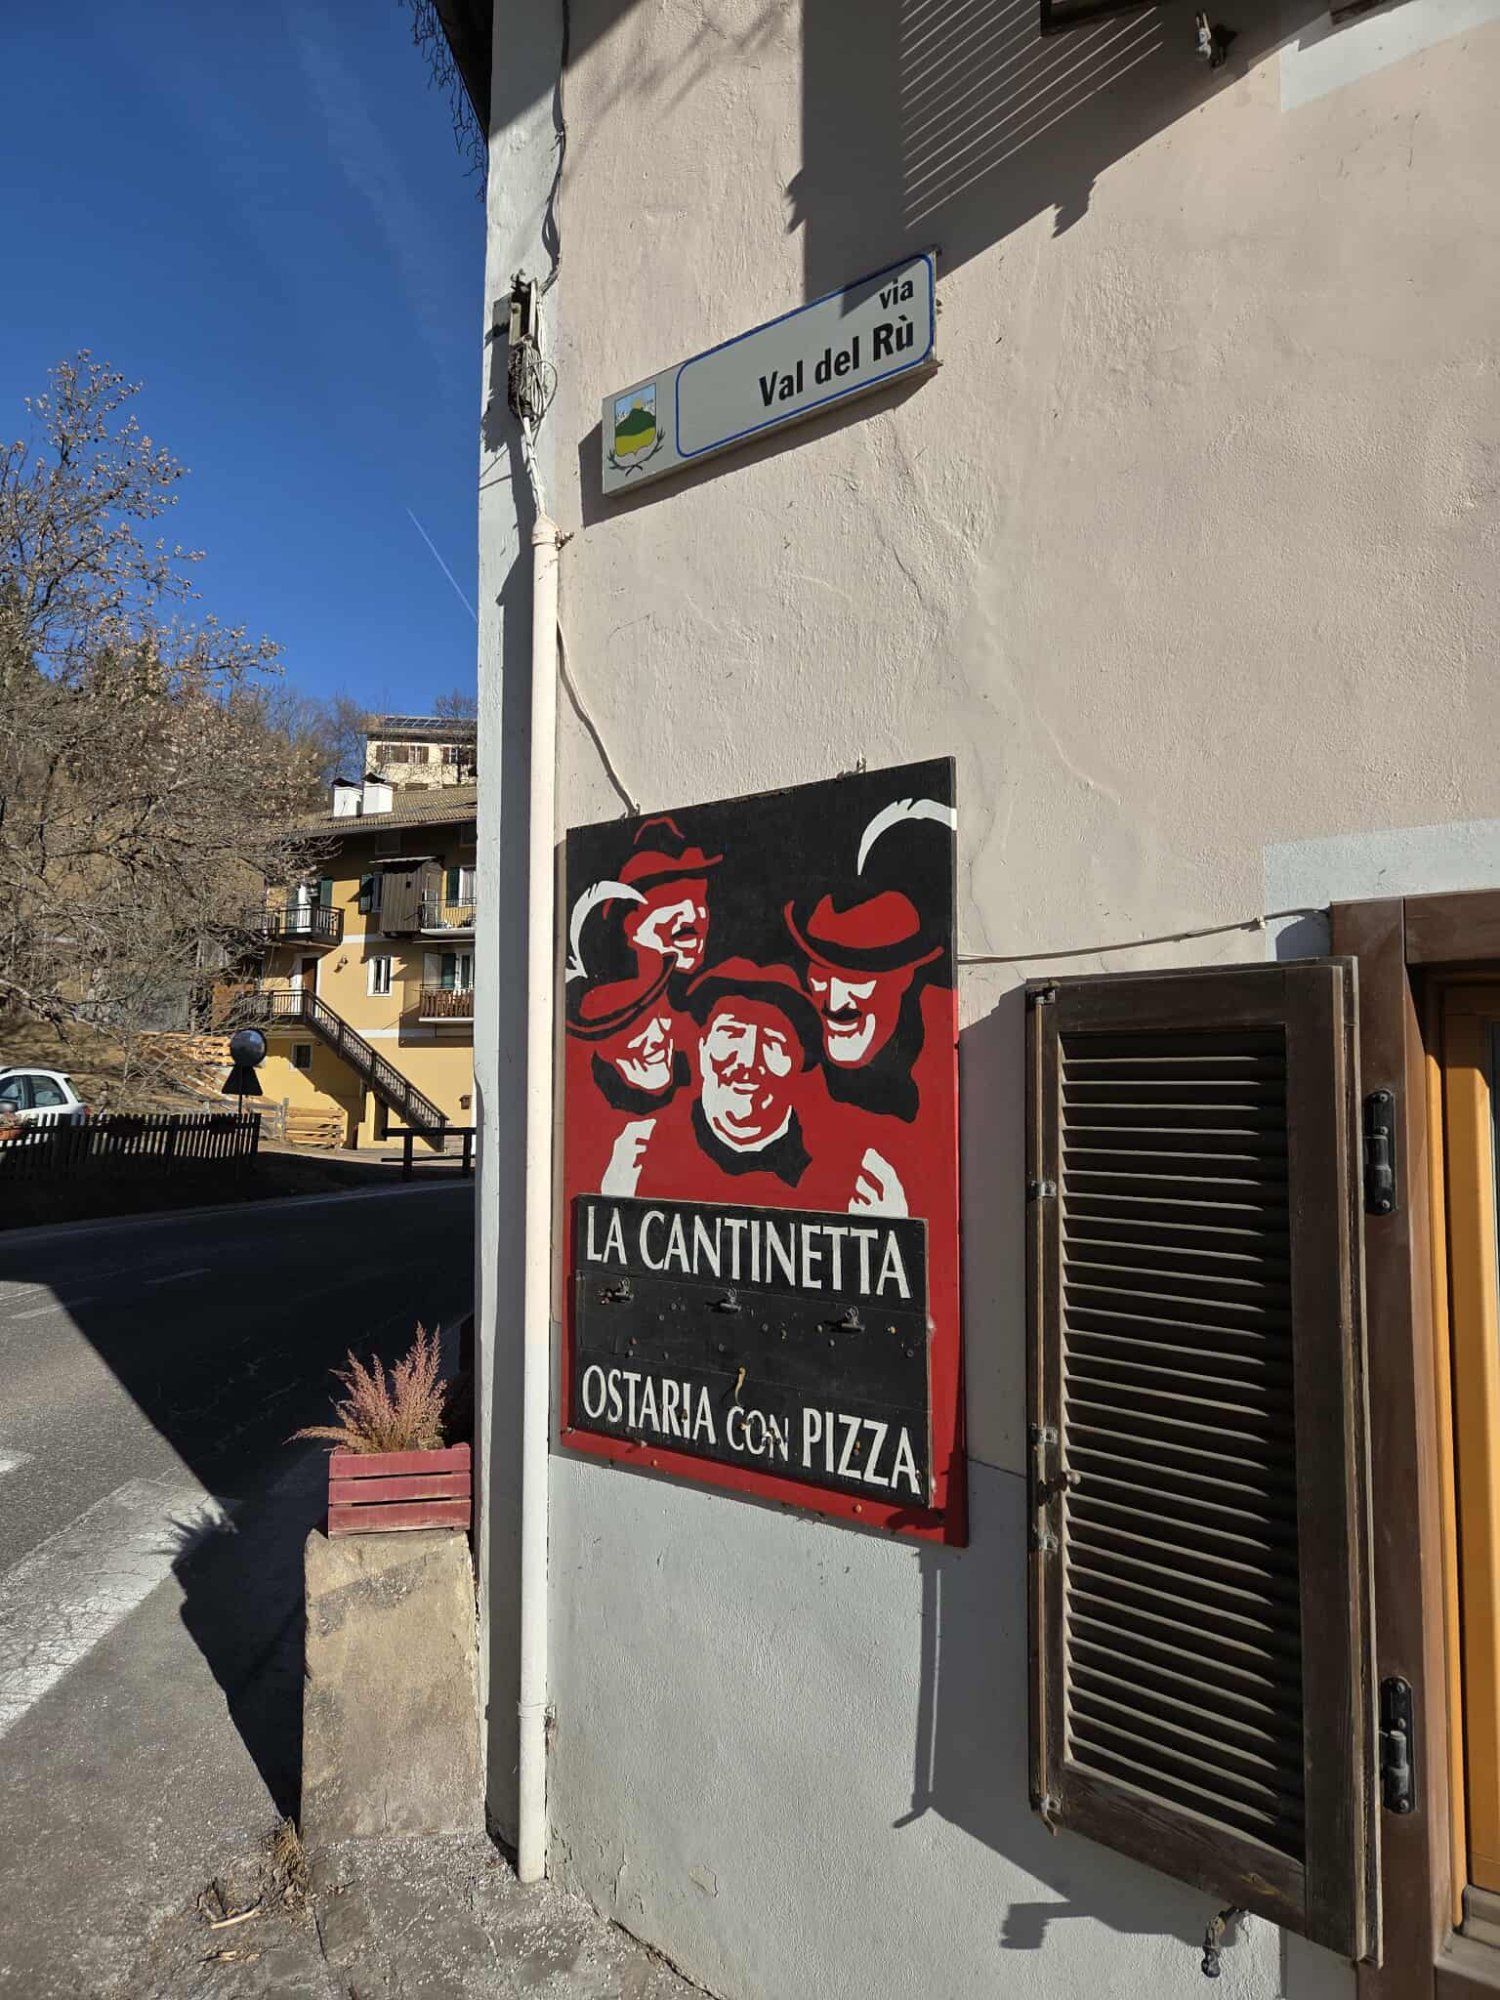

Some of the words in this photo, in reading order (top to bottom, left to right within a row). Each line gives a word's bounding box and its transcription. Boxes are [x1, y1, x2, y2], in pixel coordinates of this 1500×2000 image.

[879, 279, 914, 310] via
[758, 360, 803, 407] Val
[814, 336, 860, 385] del
[873, 315, 914, 361] Rù
[587, 1205, 627, 1265] LA
[639, 1210, 911, 1299] CANTINETTA
[582, 1364, 717, 1444] OSTARIA
[726, 1406, 789, 1462] CON
[803, 1407, 921, 1495] PIZZA
